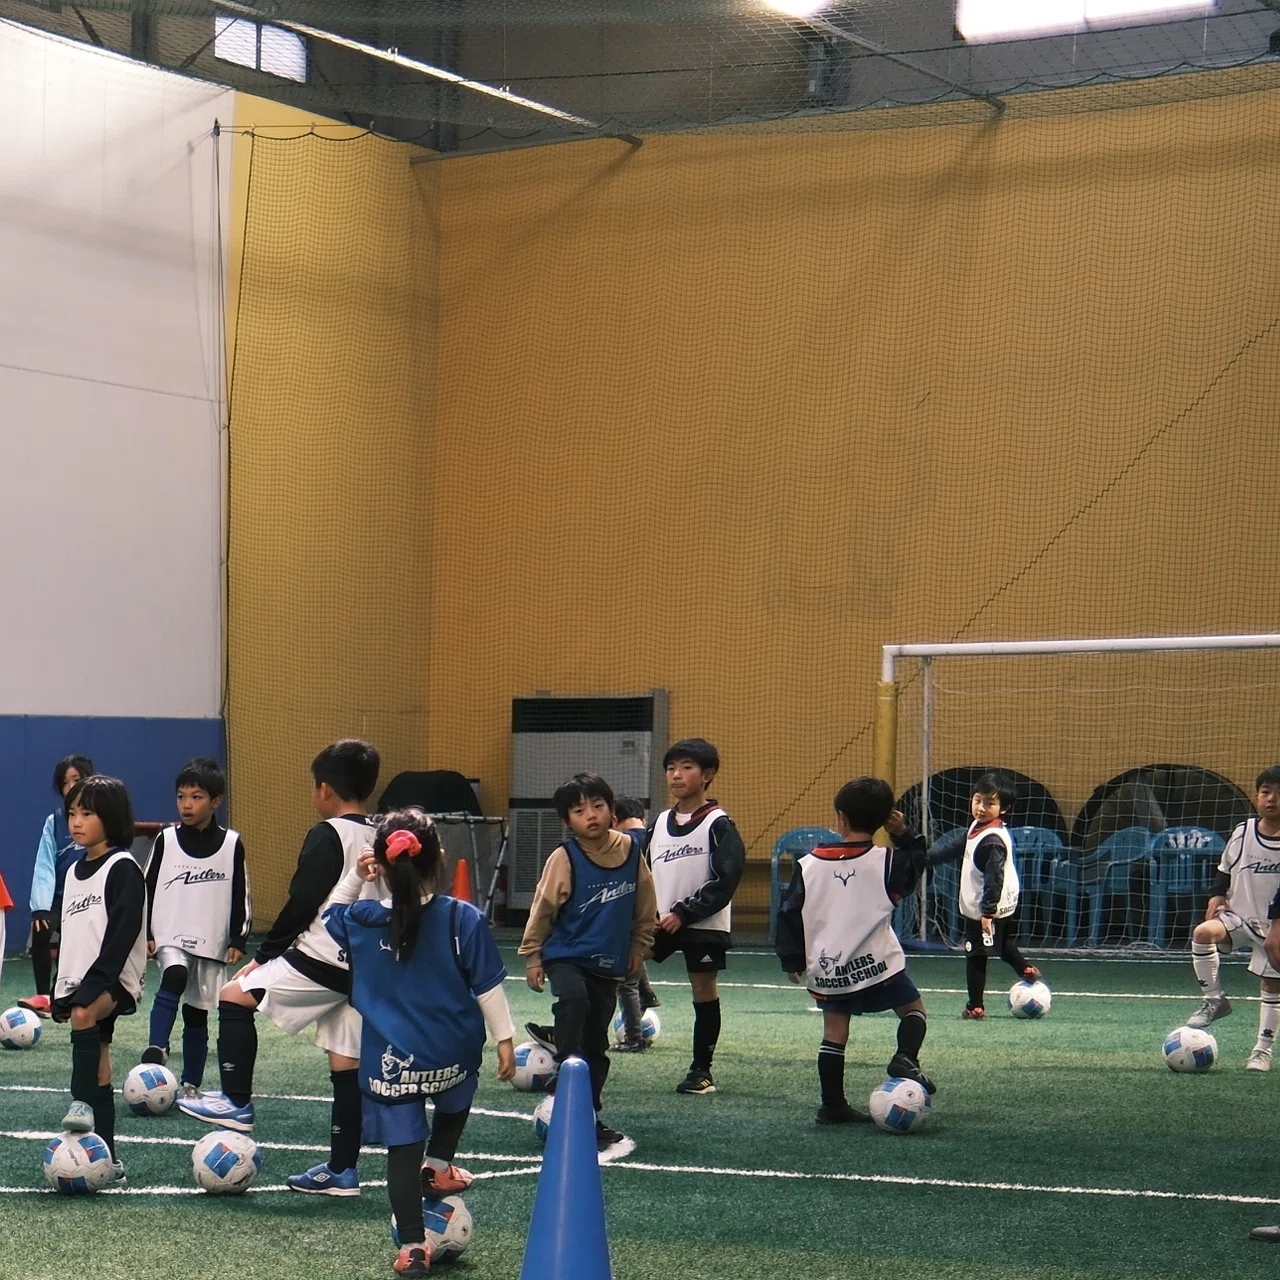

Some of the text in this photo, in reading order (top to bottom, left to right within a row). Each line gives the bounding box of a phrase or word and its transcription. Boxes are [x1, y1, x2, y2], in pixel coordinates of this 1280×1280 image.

[1238, 861, 1280, 874] Antl
[163, 868, 230, 891] Antlers
[815, 960, 889, 988] SOCCER SCHOOL
[835, 953, 875, 977] ANTLERS
[400, 1064, 460, 1084] ANTLERS
